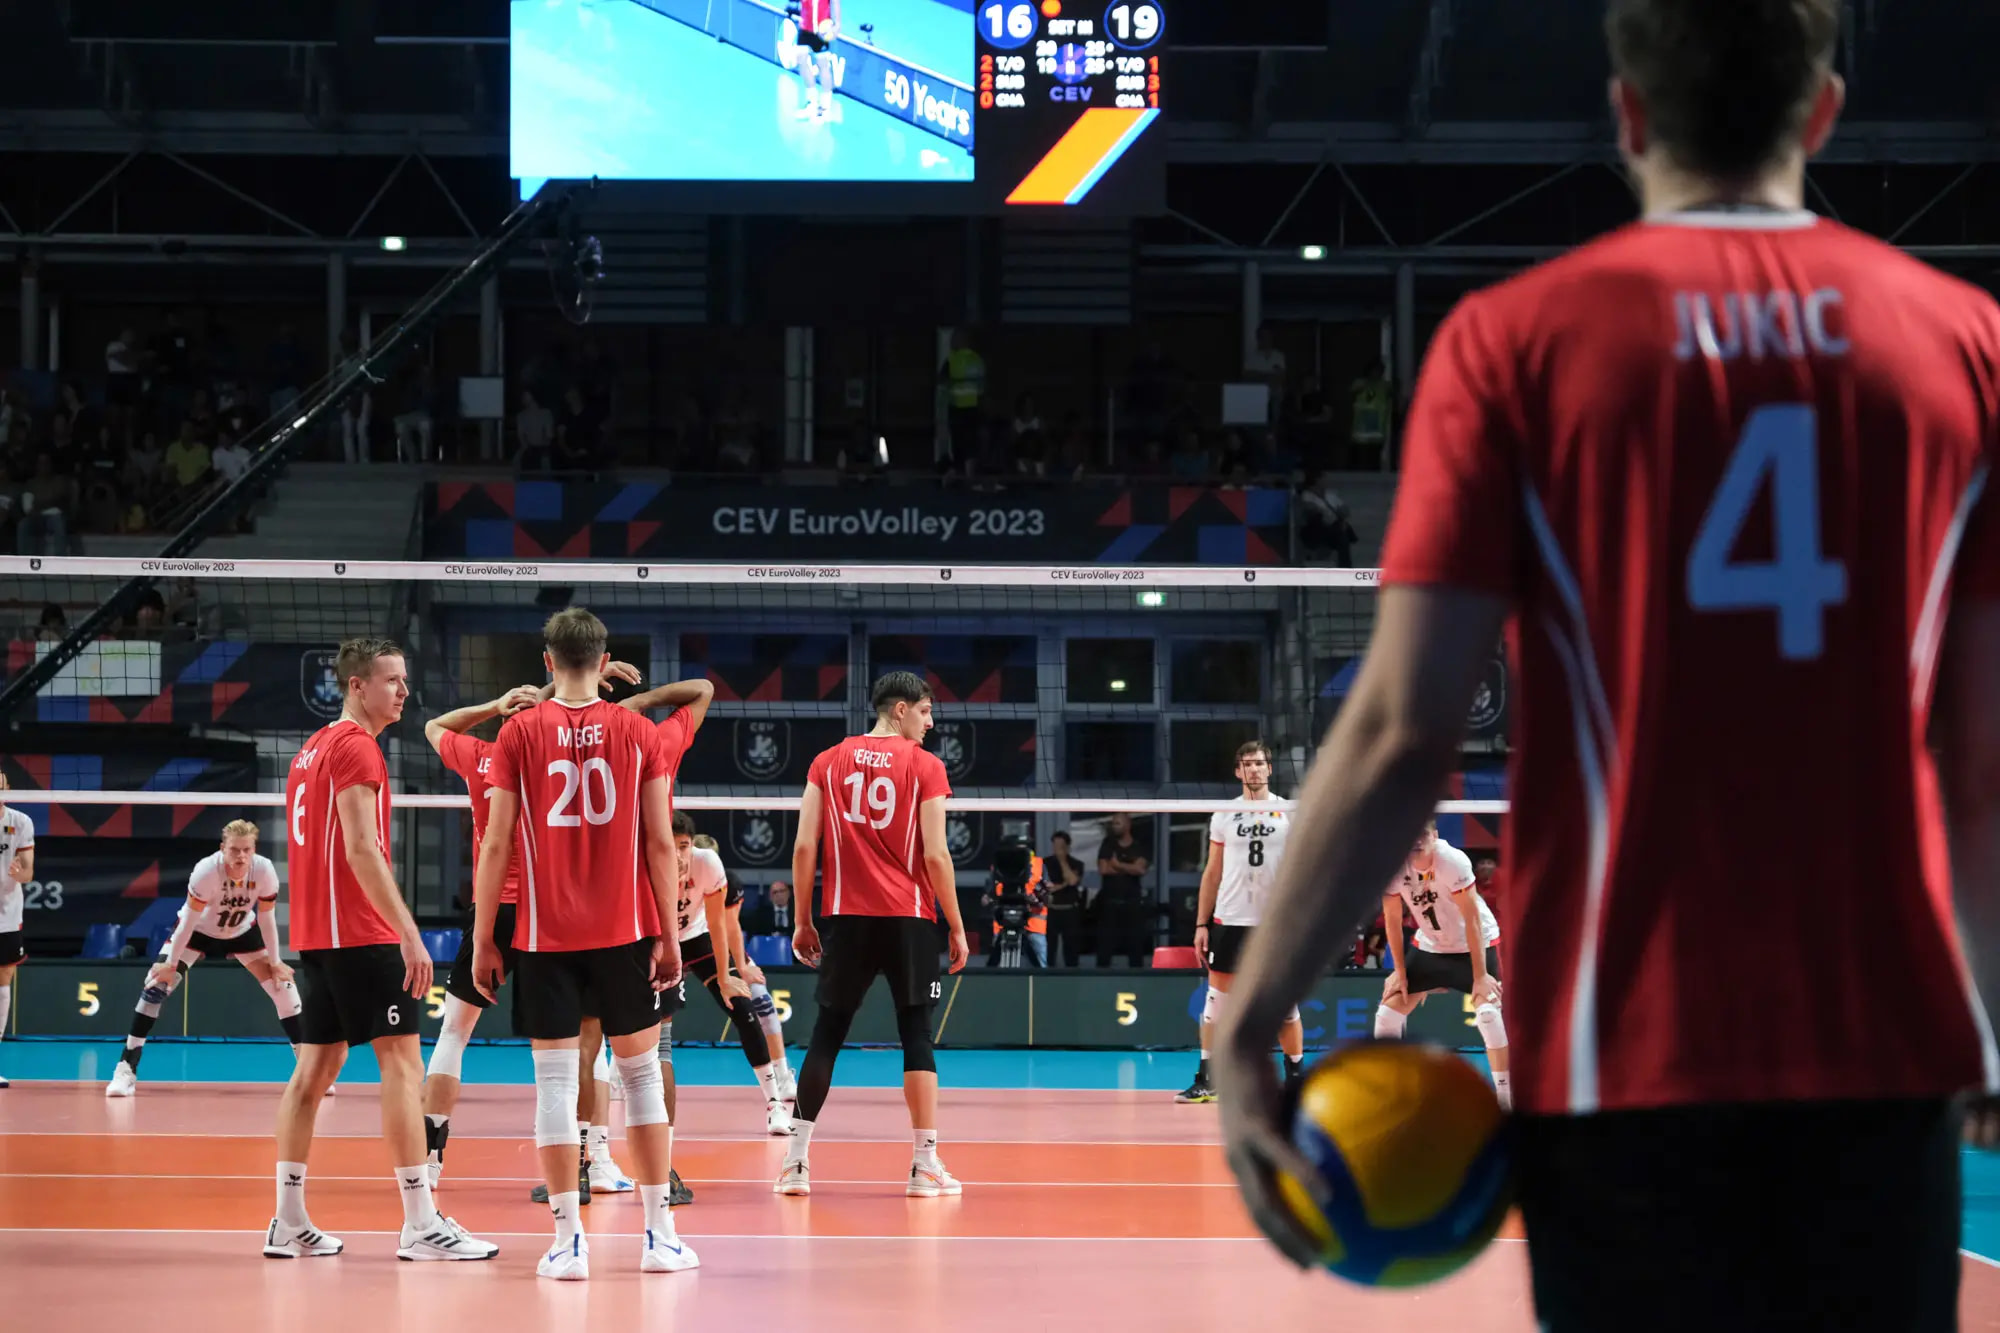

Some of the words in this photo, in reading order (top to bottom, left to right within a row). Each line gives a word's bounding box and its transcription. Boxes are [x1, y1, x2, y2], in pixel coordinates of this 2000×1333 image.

[985, 4, 1032, 38] 16
[1048, 20, 1076, 35] SET
[1111, 5, 1159, 39] 19
[980, 54, 993, 72] 2
[996, 56, 1025, 72] T/O
[1116, 57, 1145, 73] T/O
[1148, 56, 1159, 73] 1
[980, 73, 993, 90] 2
[1148, 74, 1160, 92] 3
[884, 69, 910, 109] 50
[912, 80, 970, 136] Years
[980, 91, 993, 109] 0
[1050, 86, 1093, 101] CEV
[1148, 92, 1159, 108] 1
[1673, 288, 1850, 362] JUKIC
[713, 507, 779, 533] CEV
[789, 508, 957, 541] EuroVolley
[969, 510, 1045, 535] 2023
[1686, 403, 1849, 662] 4
[141, 561, 160, 570] CEV
[163, 562, 210, 572] EuroVolley
[212, 562, 235, 571] 2023
[445, 566, 464, 575] CEV
[466, 566, 513, 576] EuroVolley
[516, 567, 538, 575] 2023
[747, 569, 767, 577] CEV
[769, 569, 816, 578] EuroVolley
[819, 569, 841, 577] 2023
[1051, 570, 1070, 580] CEV
[1072, 570, 1120, 581] EuroVolley
[1122, 571, 1145, 580] 2023
[1355, 571, 1375, 580] CEV
[854, 748, 893, 768] EREZIC
[546, 757, 617, 827] 20
[843, 771, 897, 830] 19
[292, 781, 306, 846] 6
[1248, 840, 1264, 867] 8
[217, 910, 248, 928] 10
[1421, 905, 1441, 930] 1
[77, 983, 100, 1016] 5
[930, 981, 941, 998] 19
[425, 986, 445, 1019] 5
[771, 989, 792, 1022] 5
[1116, 992, 1138, 1025] 5
[387, 1004, 401, 1026] 6
